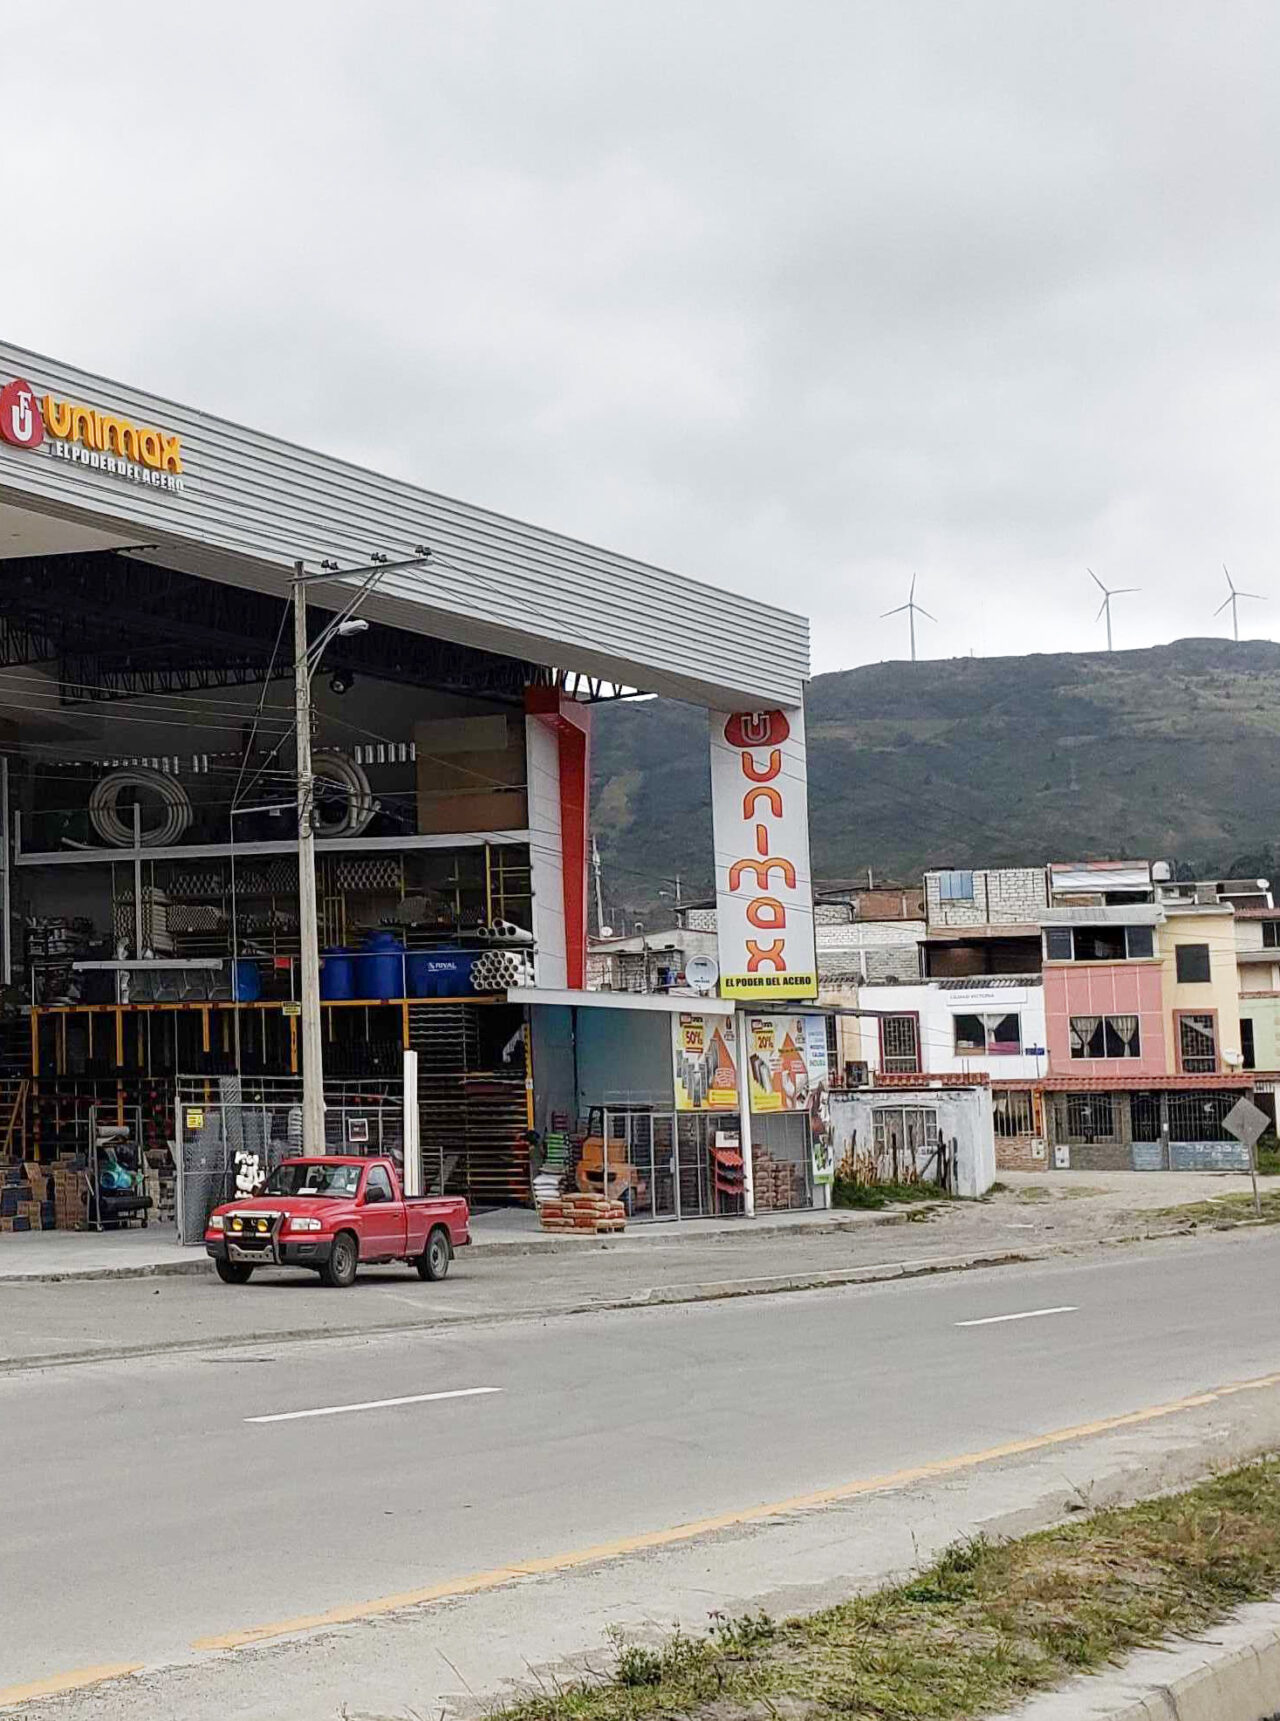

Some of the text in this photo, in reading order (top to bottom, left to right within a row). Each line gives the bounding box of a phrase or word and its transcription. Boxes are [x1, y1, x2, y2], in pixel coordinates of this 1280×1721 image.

[56, 441, 185, 491] EL PODER DEL ACERO
[725, 976, 811, 987] EL PODER DEL ACERO
[685, 1030, 703, 1045] 50%
[758, 1035, 774, 1049] 20%
